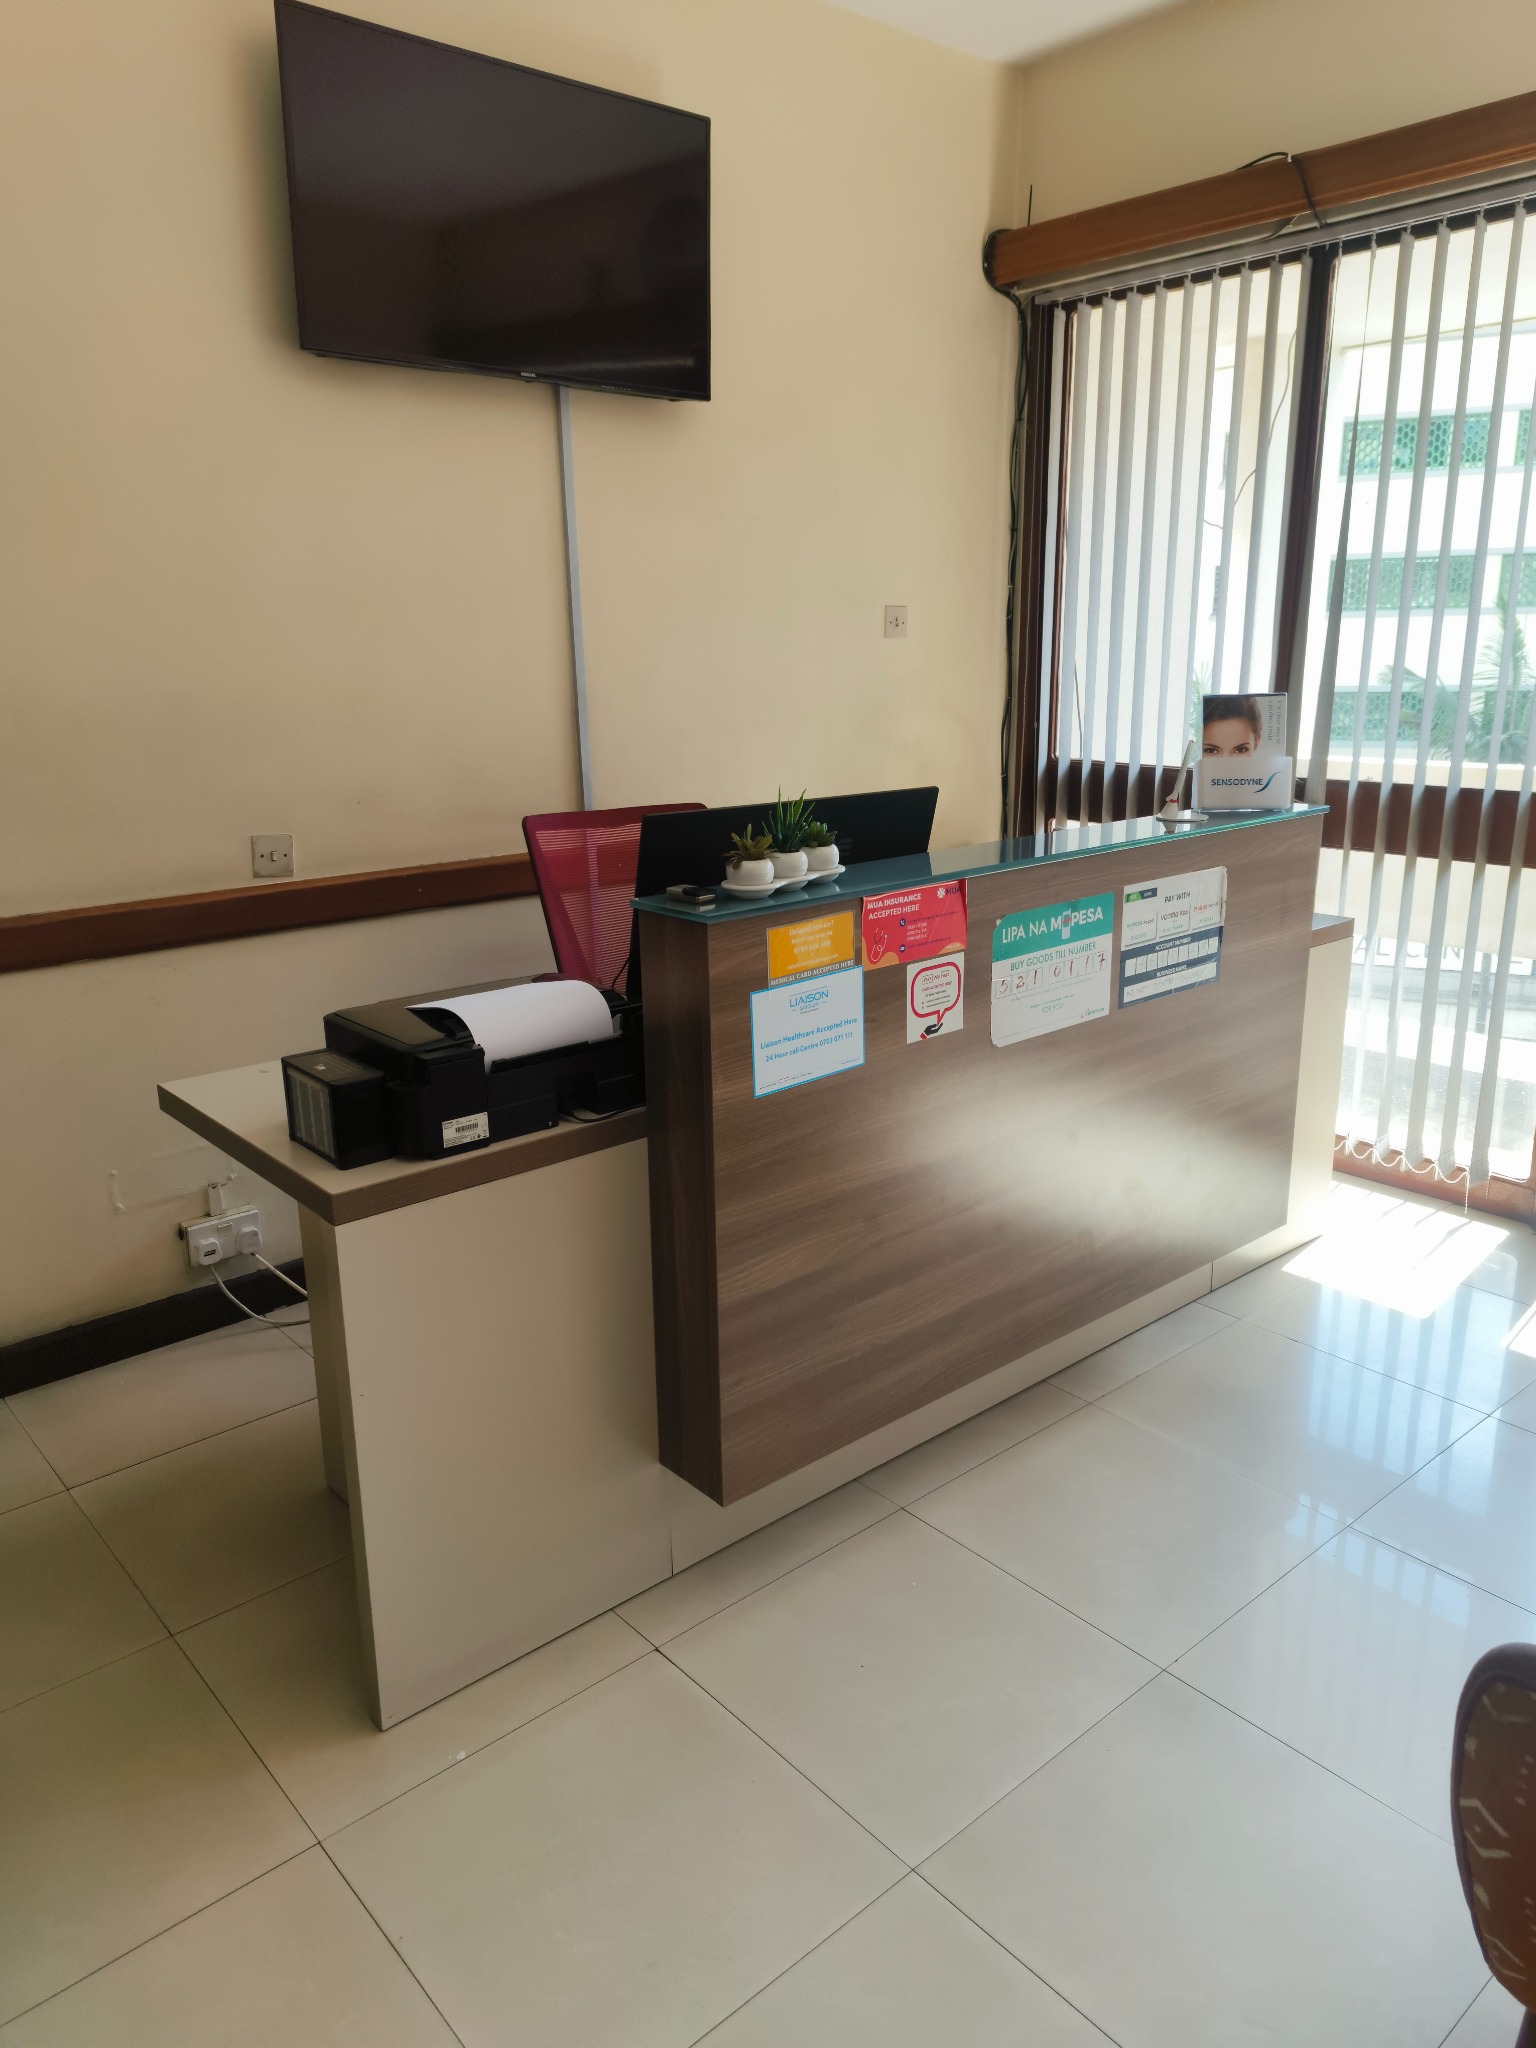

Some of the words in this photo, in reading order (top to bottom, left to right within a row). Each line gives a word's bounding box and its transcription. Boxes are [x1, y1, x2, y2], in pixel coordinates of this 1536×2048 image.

[1211, 778, 1263, 786] SENSODYNE
[945, 885, 961, 896] MUA
[1164, 895, 1175, 904] PAY
[1176, 891, 1191, 901] WITH
[867, 900, 883, 910] MUA
[884, 893, 922, 907] INSURANCE
[868, 907, 902, 920] ACCEPTED
[903, 904, 920, 913] HERE
[1002, 924, 1026, 944] LIPA
[1029, 919, 1048, 937] NA
[1010, 959, 1025, 972] BUY
[1026, 953, 1054, 967] GOODS
[1055, 948, 1067, 960] TILL
[1068, 941, 1097, 956] NUMBER
[770, 972, 795, 986] MEDICAL
[796, 970, 812, 980] CARD
[812, 962, 840, 976] ACCEPTED
[840, 960, 854, 969] HERE
[789, 989, 829, 1008] LIAISON
[760, 1036, 782, 1050] Liaison
[782, 1029, 815, 1044] Healthcare
[816, 1020, 843, 1034] Accepted
[843, 1017, 858, 1026] Here
[774, 1051, 789, 1059] Hour
[789, 1047, 800, 1055] call
[800, 1042, 819, 1052] Centre
